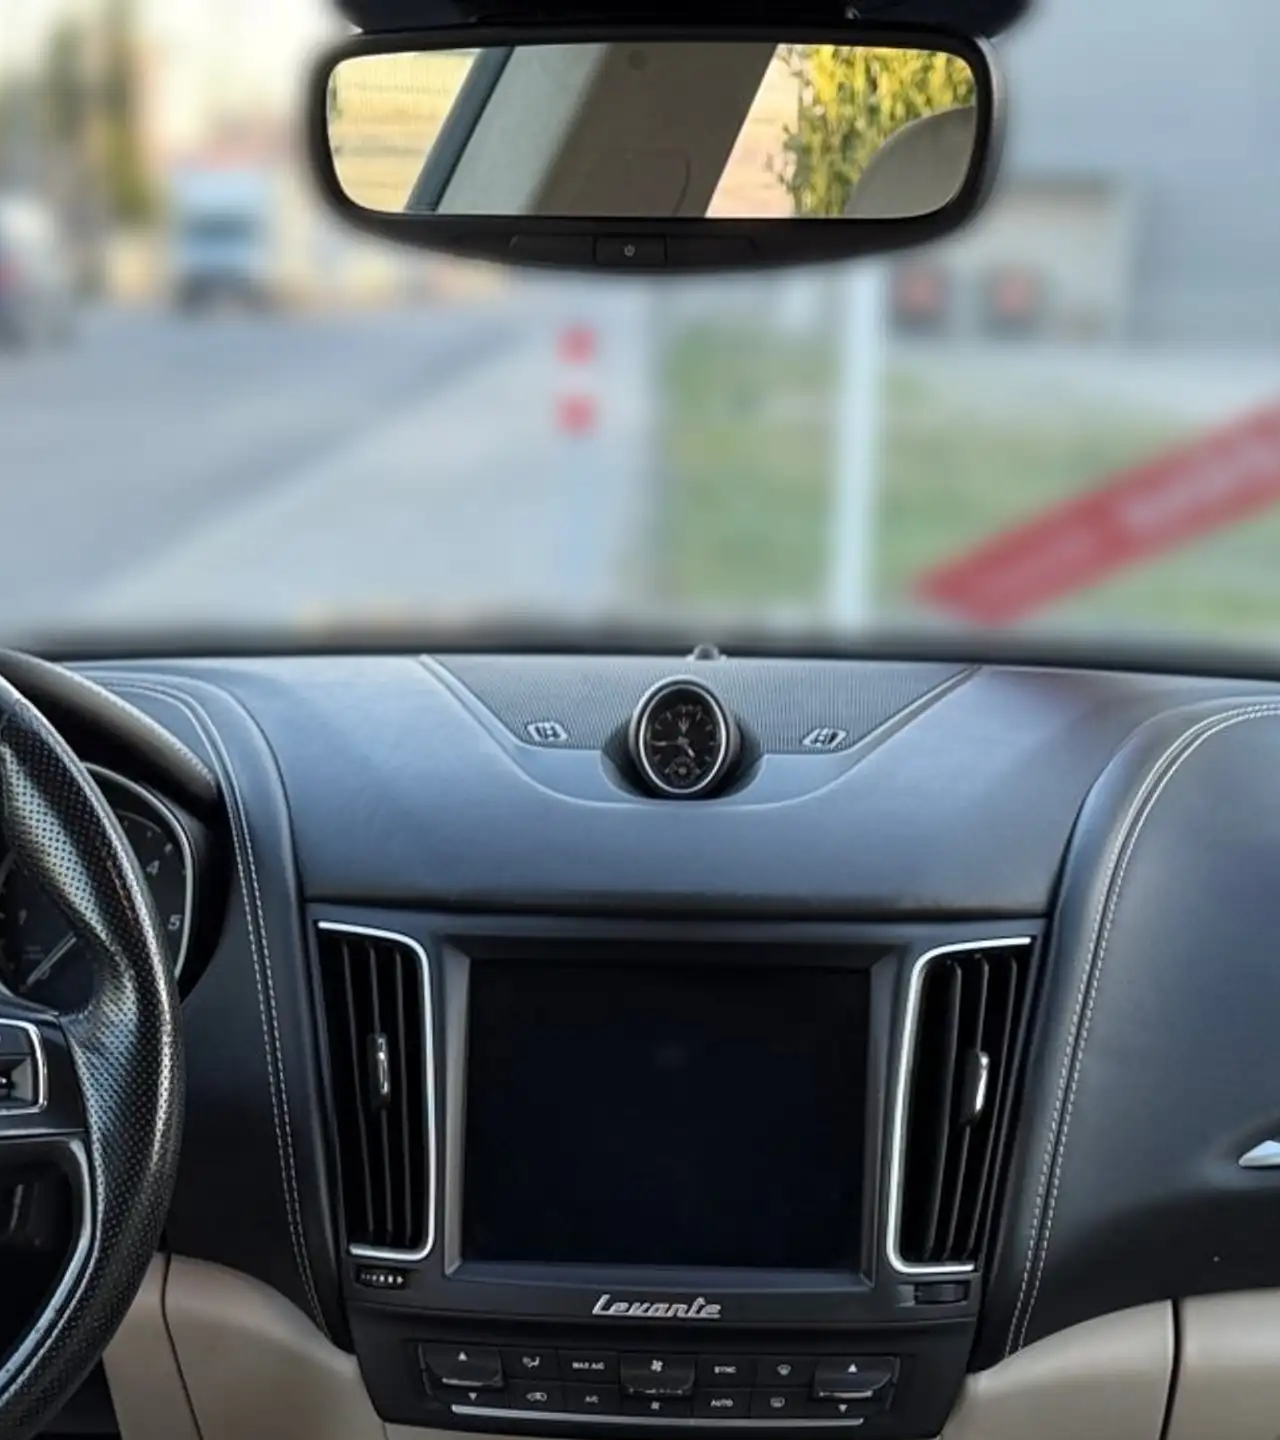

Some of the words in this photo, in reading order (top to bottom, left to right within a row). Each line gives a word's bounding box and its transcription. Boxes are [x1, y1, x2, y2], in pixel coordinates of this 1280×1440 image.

[146, 860, 161, 875] 4
[167, 914, 182, 930] 5
[592, 1293, 722, 1319] Levante
[710, 1398, 734, 1408] AUTO
